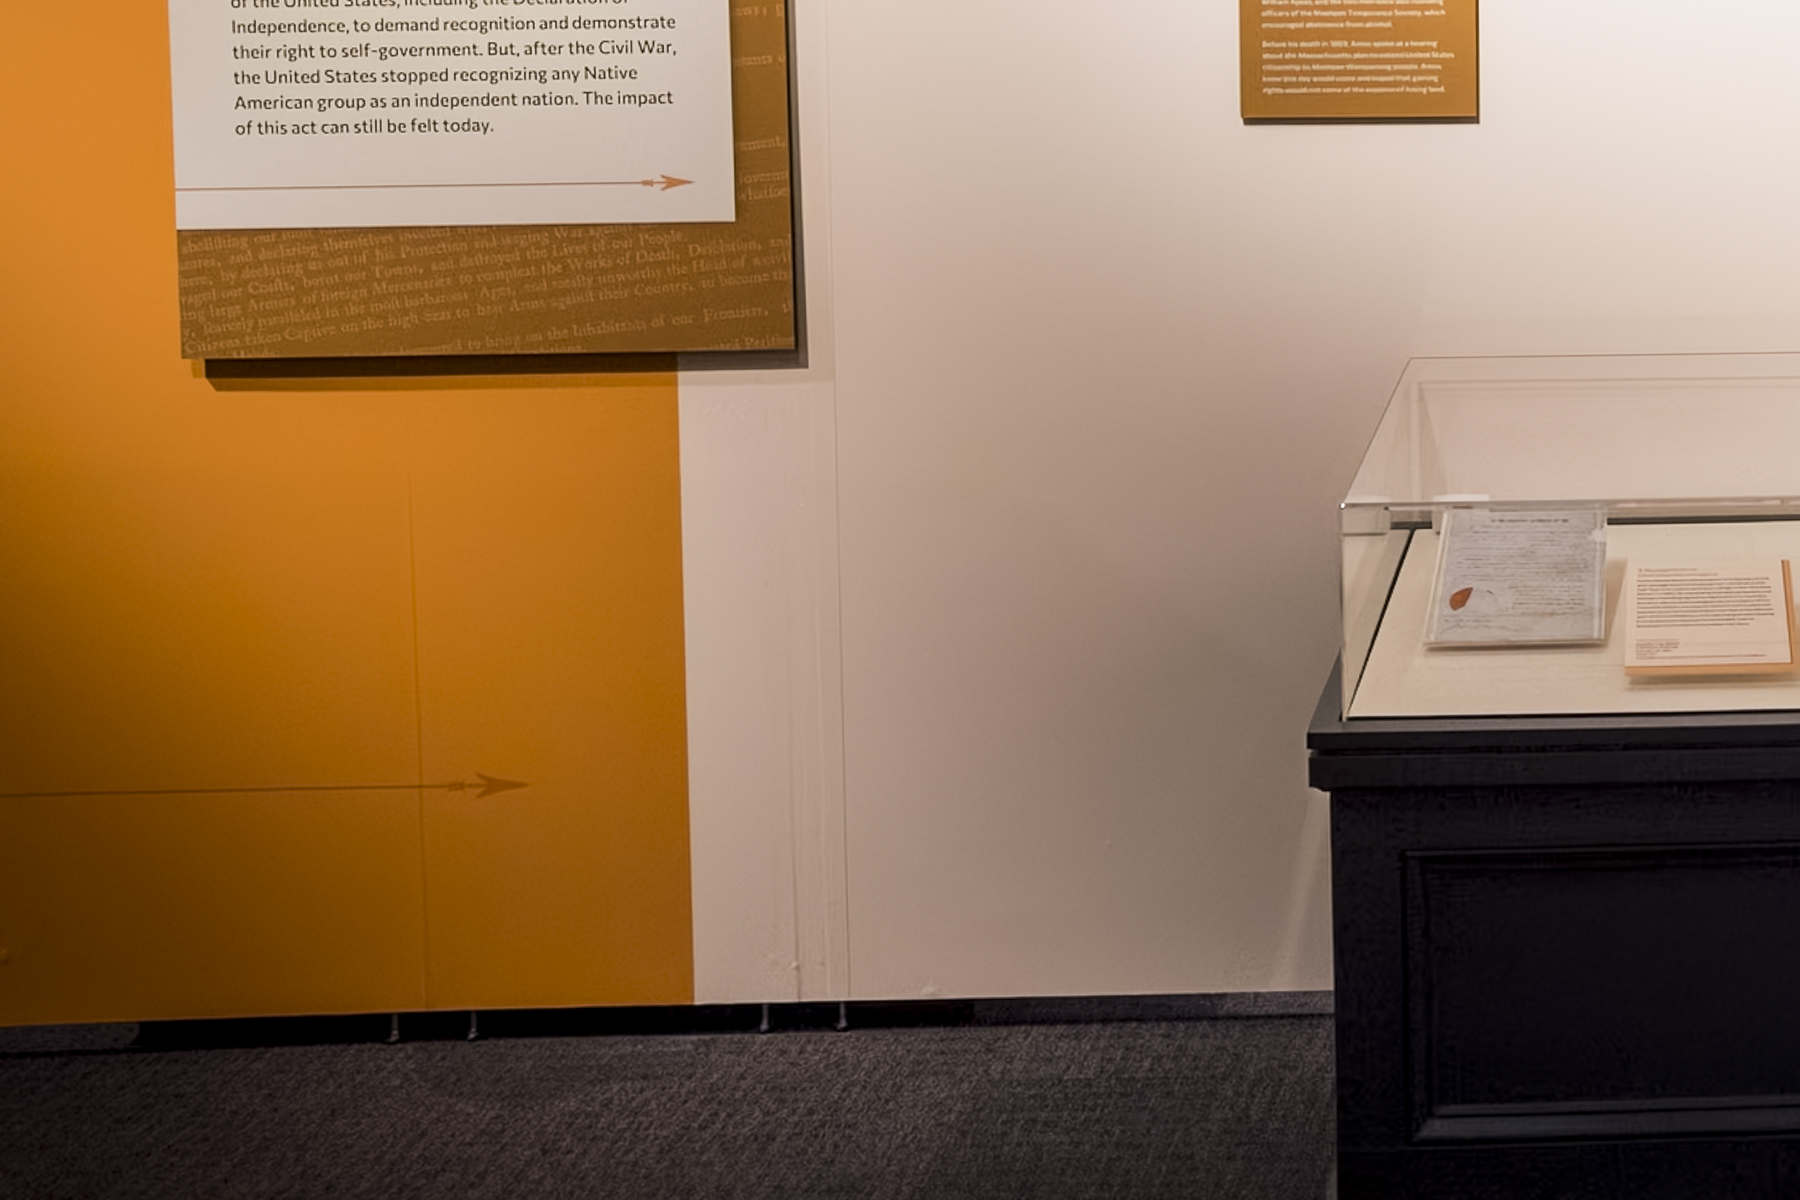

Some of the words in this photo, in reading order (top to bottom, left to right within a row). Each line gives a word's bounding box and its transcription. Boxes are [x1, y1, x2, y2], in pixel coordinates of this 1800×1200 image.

[234, 95, 313, 109] American
[316, 98, 366, 111] group
[369, 97, 386, 108] as
[391, 97, 410, 107] an
[414, 92, 517, 109] independent
[522, 92, 578, 105] nation.
[582, 91, 613, 104] The
[617, 90, 673, 107] impact
[235, 120, 252, 134] of
[256, 121, 288, 134] this
[291, 121, 317, 134] act
[320, 123, 349, 134] can
[353, 119, 382, 133] still
[387, 119, 406, 132] be
[410, 118, 439, 132] felt
[442, 118, 493, 134] today.
